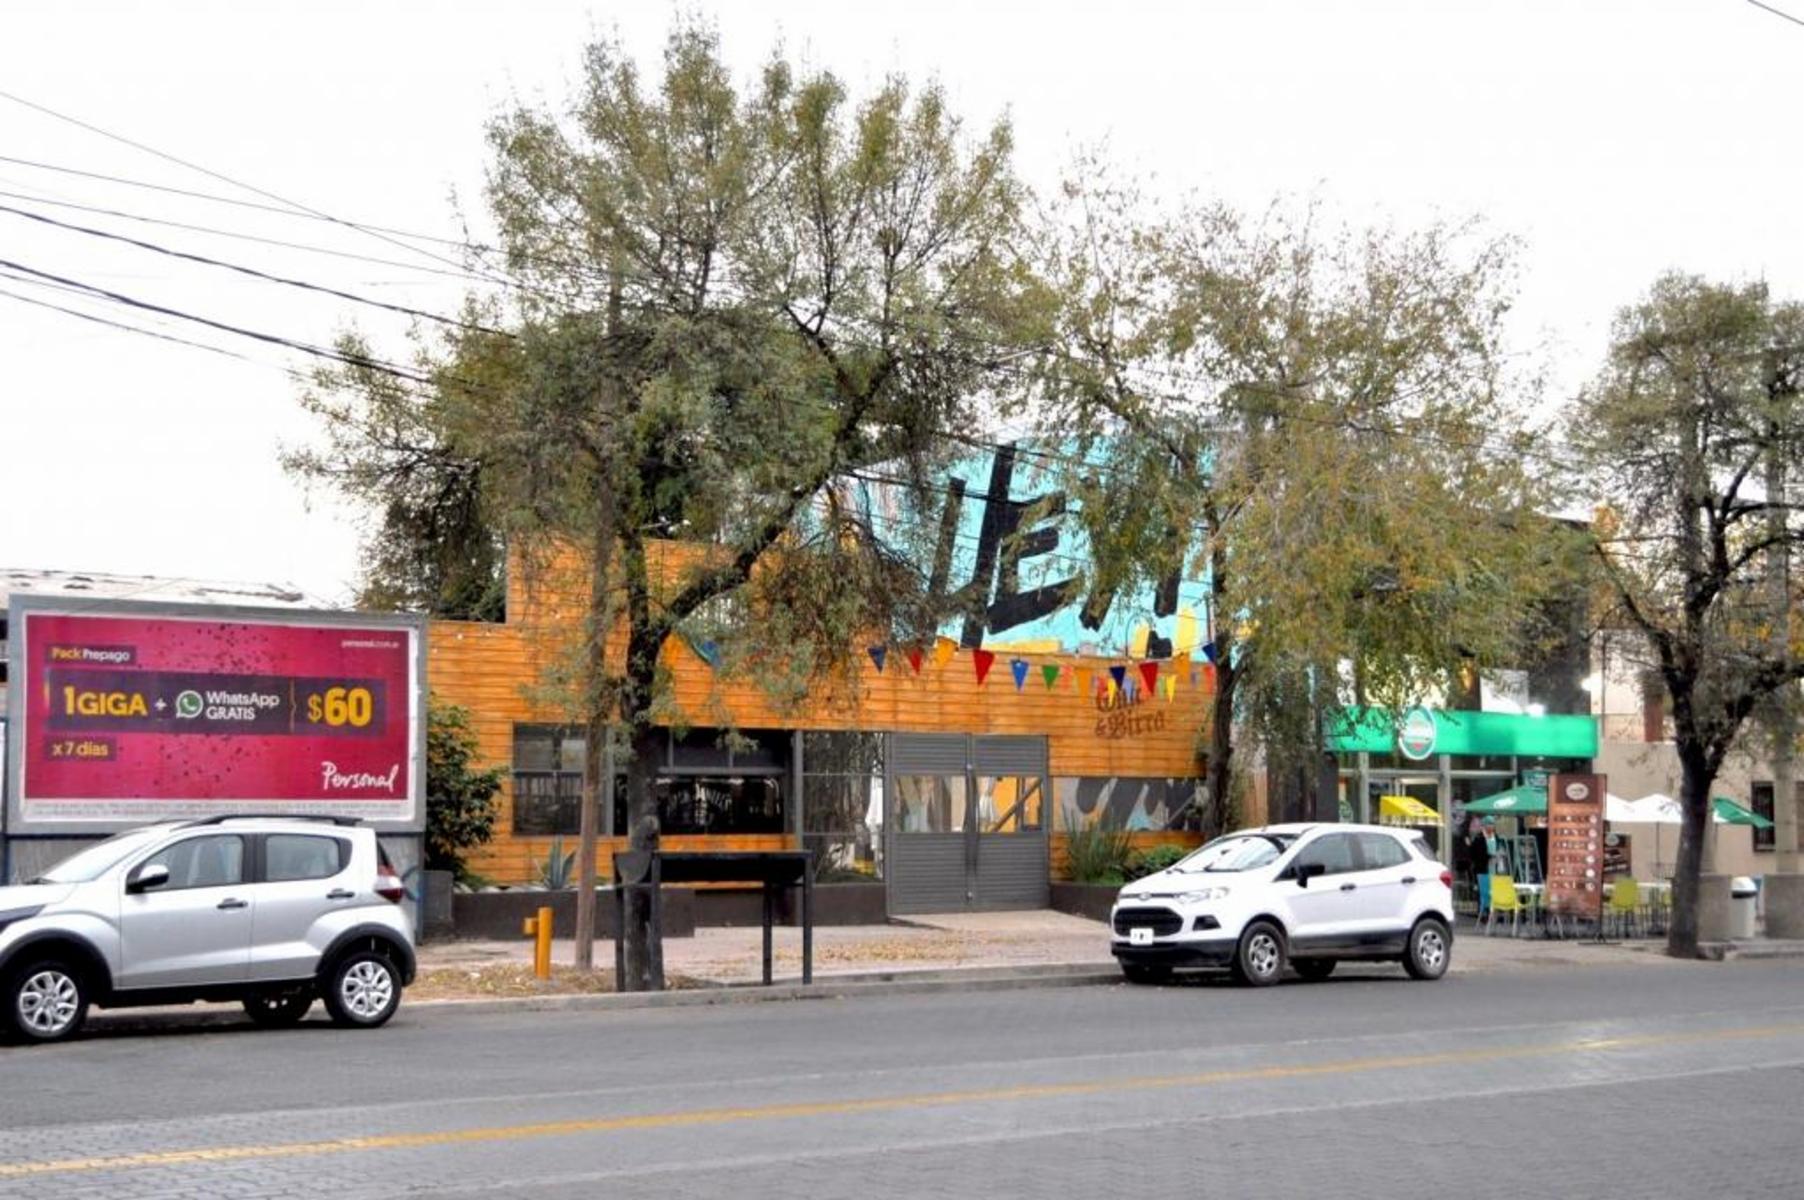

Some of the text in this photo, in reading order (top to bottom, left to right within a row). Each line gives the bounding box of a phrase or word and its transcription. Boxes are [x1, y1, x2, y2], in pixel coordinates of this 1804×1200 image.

[52, 647, 130, 663] Pack Prepago
[206, 691, 280, 709] WhatsApp
[307, 687, 373, 727] $60
[206, 706, 256, 720] GRATIS
[65, 743, 74, 755] 7
[321, 761, 399, 792] Personal
